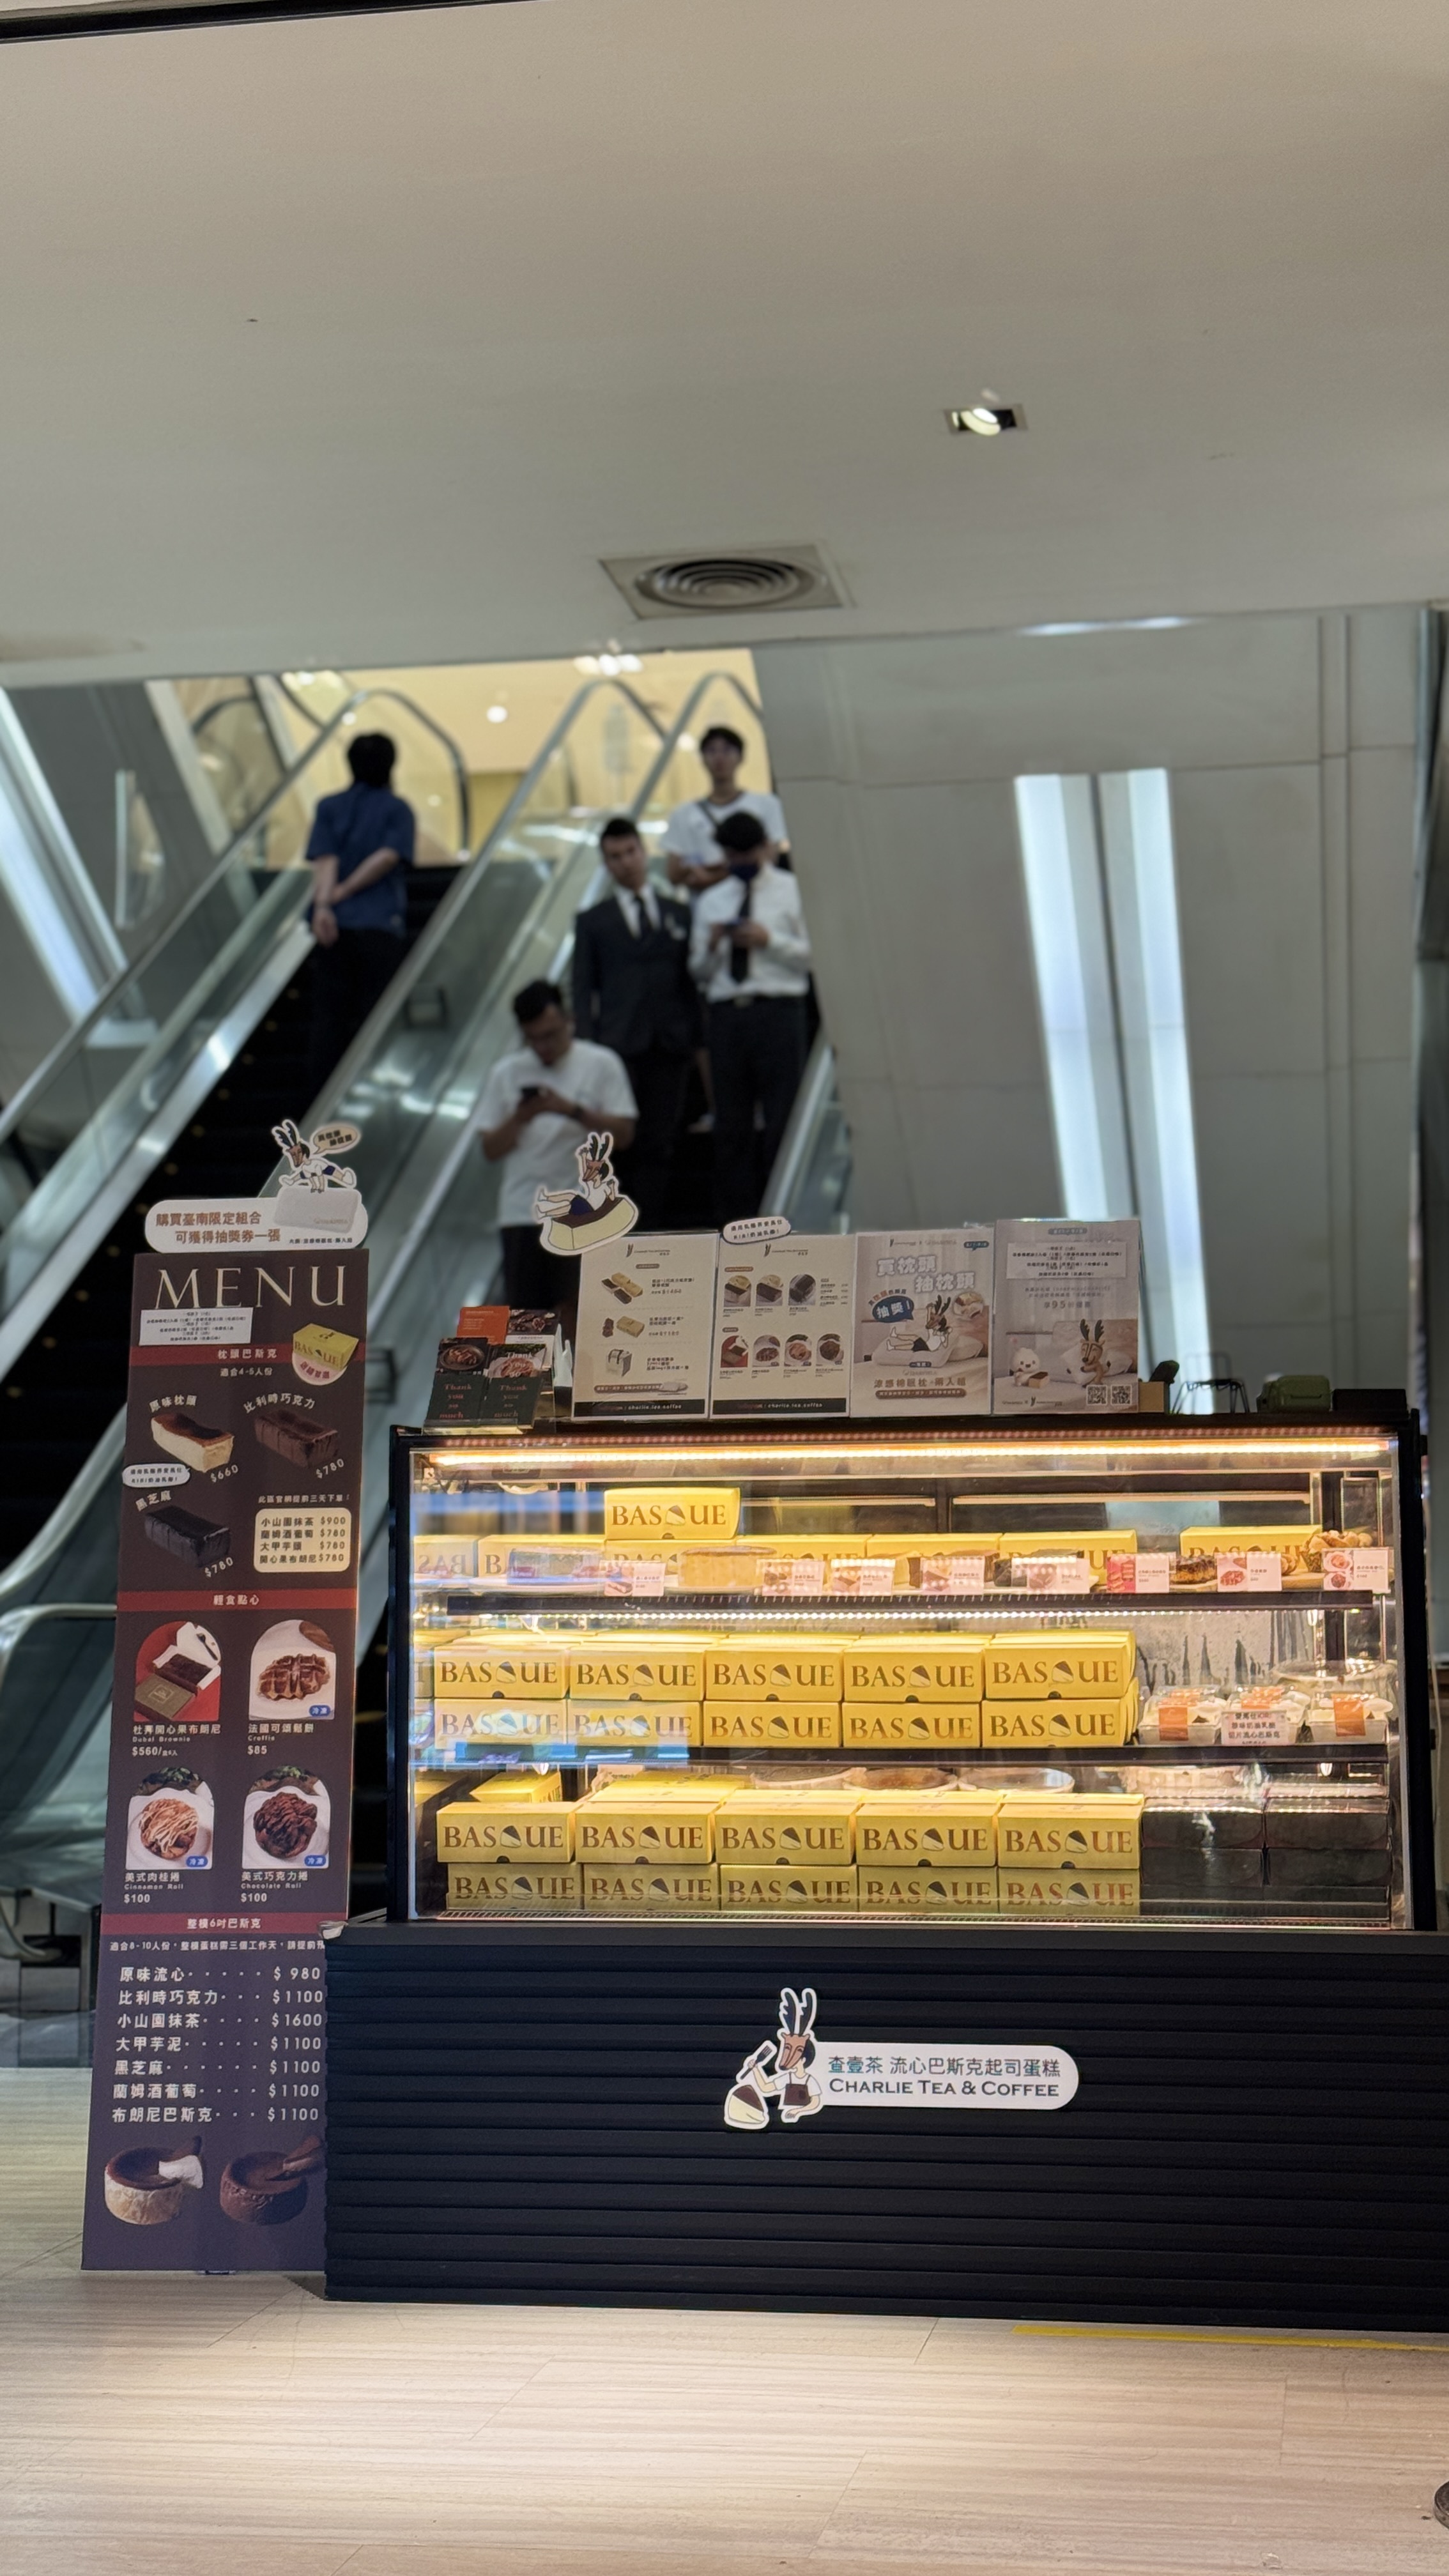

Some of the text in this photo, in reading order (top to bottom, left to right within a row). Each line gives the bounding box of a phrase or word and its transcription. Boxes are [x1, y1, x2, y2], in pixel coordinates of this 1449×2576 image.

[156, 1211, 261, 1227] 購買臺南限定組合
[175, 1229, 281, 1245] 可獲得抽獎券一張
[155, 1266, 346, 1308] MENU
[914, 1272, 975, 1293] 抽枕頭
[218, 1349, 277, 1360] 枕頭巴斯克
[150, 1395, 197, 1413] 原味枕頭
[243, 1393, 315, 1413] 比利時巧克力
[210, 1464, 238, 1482] $660
[316, 1459, 344, 1479] $780
[135, 1490, 171, 1512] 黑芝麻
[320, 1516, 346, 1525] $900
[320, 1528, 346, 1537] $780
[259, 1540, 345, 1551] 大甲芋頭 $780
[319, 1553, 344, 1562] $780
[204, 1557, 233, 1577] $780
[213, 1595, 259, 1606] 輕食點心
[248, 1723, 314, 1733] 法國可頌鬆餅
[247, 1745, 267, 1756] $85
[124, 1894, 151, 1904] $100
[240, 1892, 267, 1903] $100
[187, 1917, 261, 1929] 整模6吋巴斯克
[119, 1966, 185, 1982] 原味流心
[118, 1989, 217, 2005] 比利時巧克力
[117, 2012, 200, 2029] 小山園抹茶
[116, 2036, 182, 2052] 大甲芋泥
[114, 2060, 164, 2075] 黑芝麻
[828, 2055, 1061, 2078] 查壹茶 流心巴斯克起司蛋糕
[113, 2083, 197, 2099] 蘭姆酒葡萄
[829, 2078, 1059, 2097] CHARLIE TEA & COFFEE
[112, 2107, 212, 2123] 布朗尼巴斯克
